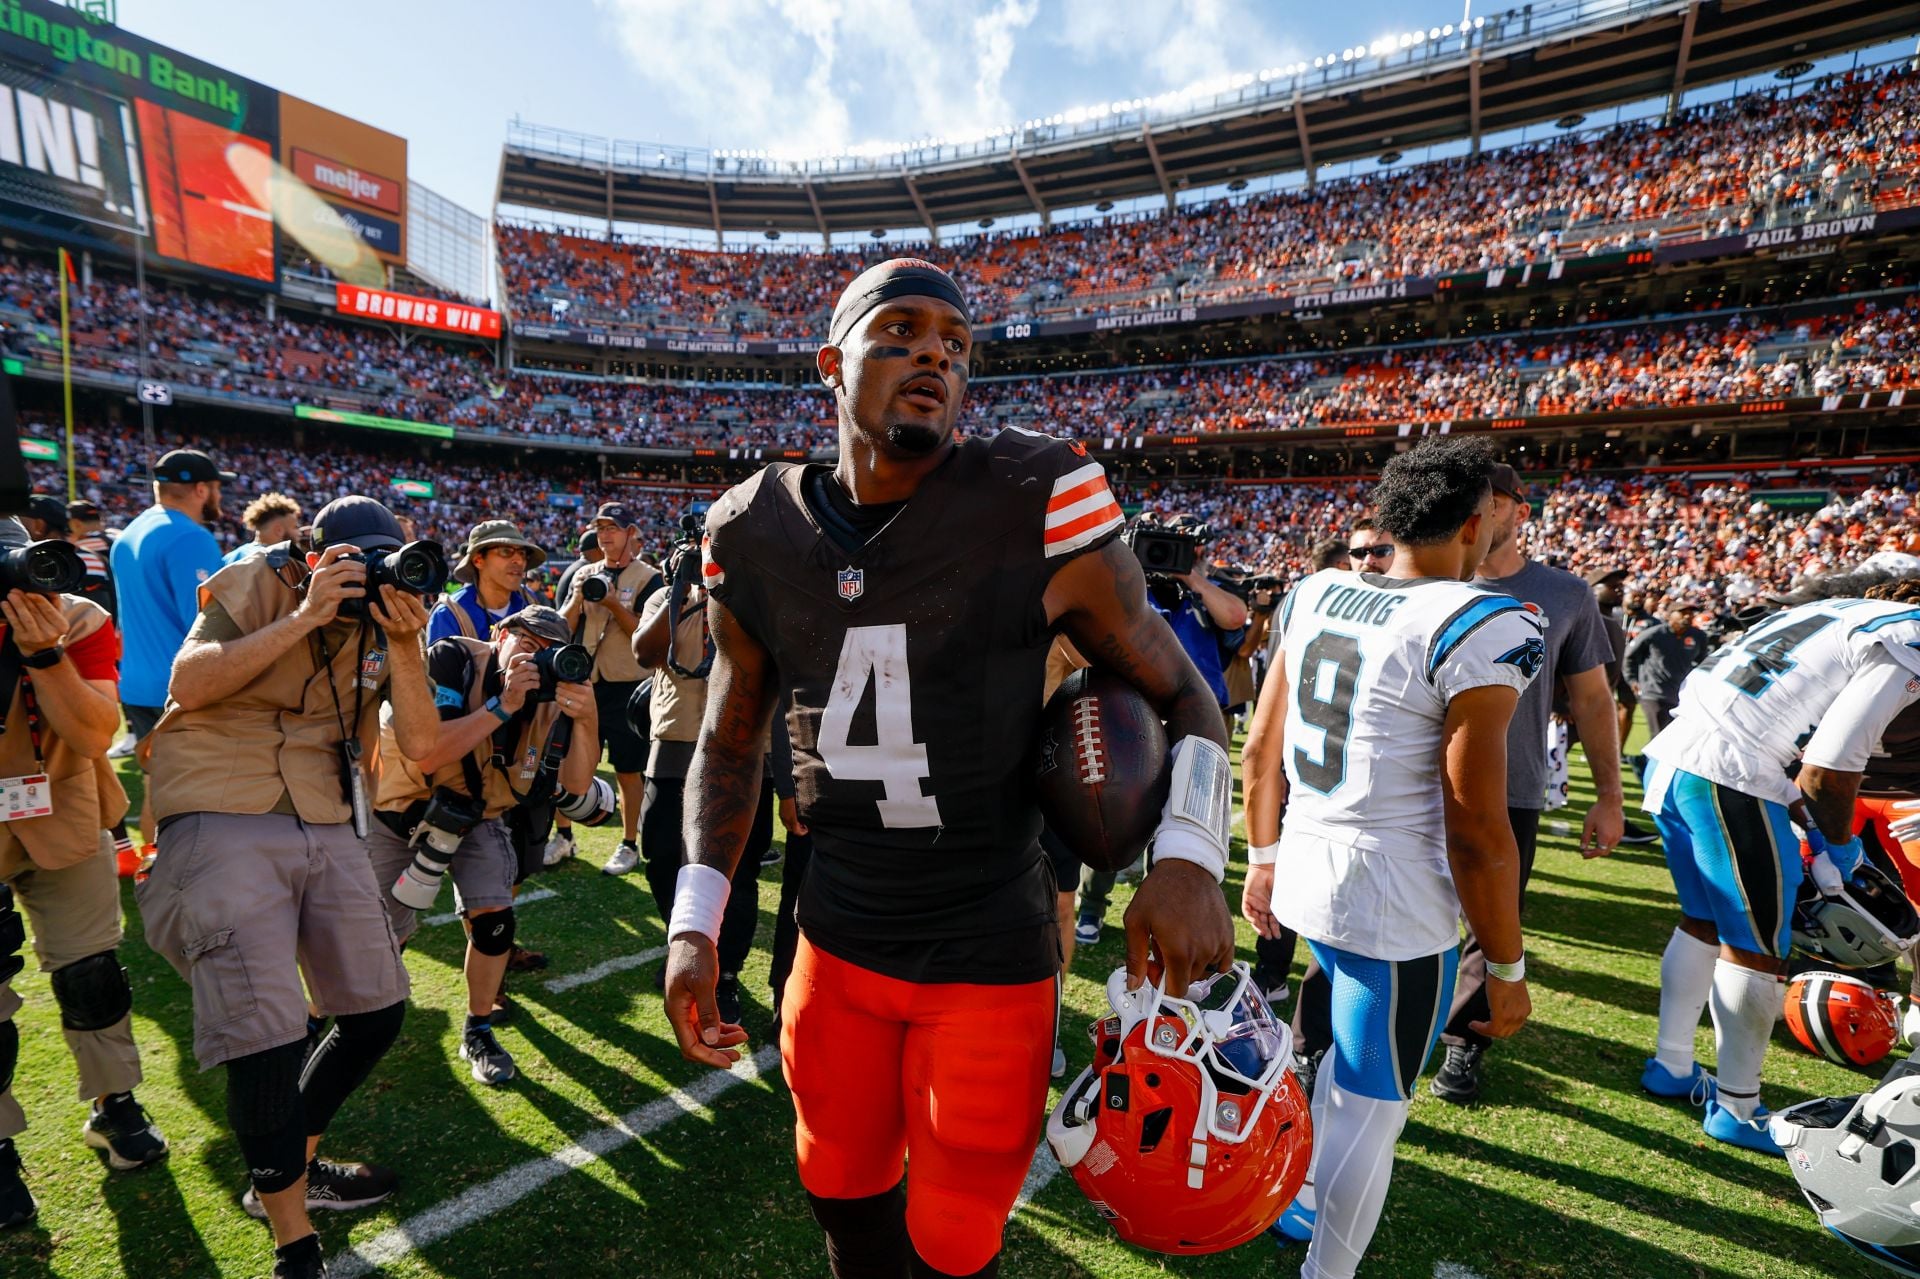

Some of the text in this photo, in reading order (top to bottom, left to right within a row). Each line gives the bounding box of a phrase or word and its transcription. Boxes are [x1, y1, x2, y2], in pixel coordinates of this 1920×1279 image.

[149, 52, 240, 114] Bank
[314, 163, 381, 200] meijer
[1745, 214, 1878, 249] PAUL BROWN
[356, 291, 482, 332] BROWNS WIN
[1294, 282, 1407, 309] OTTO GRAHAM 14
[1096, 313, 1131, 330] DANTE
[1133, 309, 1178, 325] LAVELLI
[608, 335, 632, 347] FORD
[667, 339, 688, 351] CLAY
[688, 341, 734, 354] MATTHEWS
[841, 581, 861, 595] NFL
[1313, 582, 1409, 628] YOUNG
[817, 623, 943, 830] 4
[1293, 628, 1366, 798] 9
